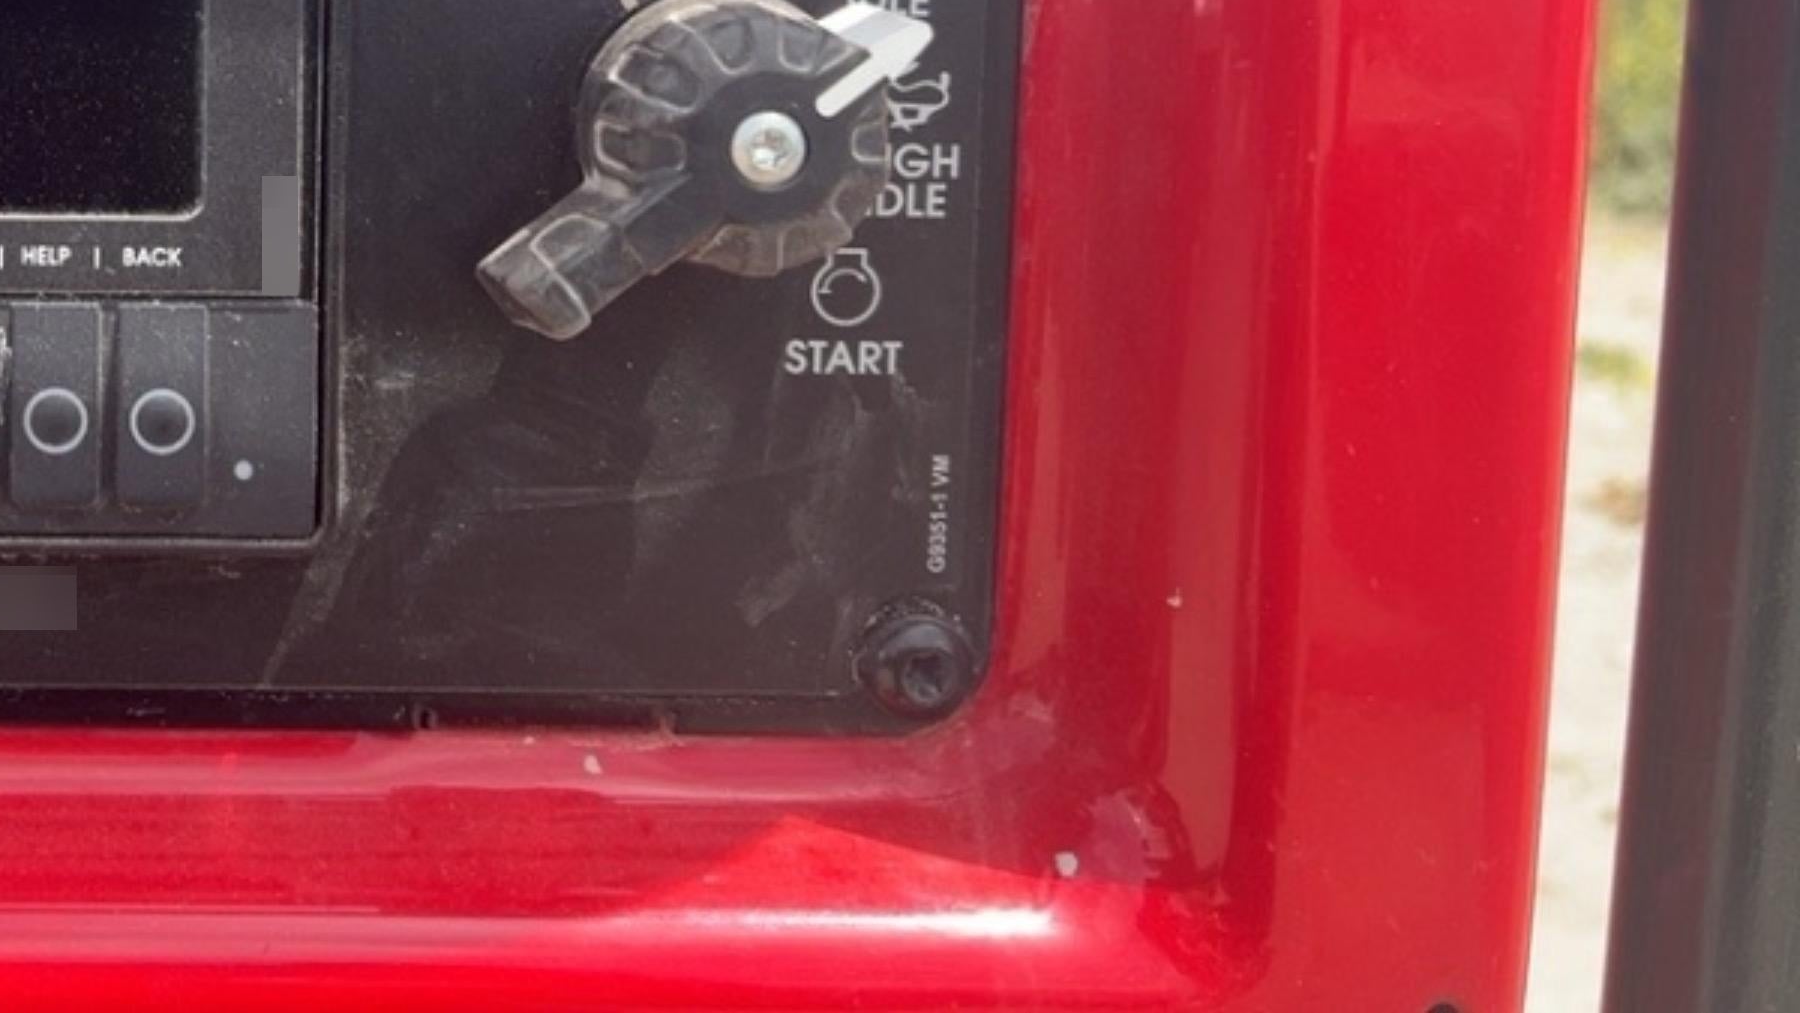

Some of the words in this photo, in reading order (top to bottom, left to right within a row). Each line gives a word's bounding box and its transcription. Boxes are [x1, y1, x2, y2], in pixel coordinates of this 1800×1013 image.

[865, 183, 947, 218] DLE
[20, 245, 73, 267] HELP
[121, 246, 184, 268] BACK
[783, 339, 905, 376] START
[930, 453, 951, 486] VM
